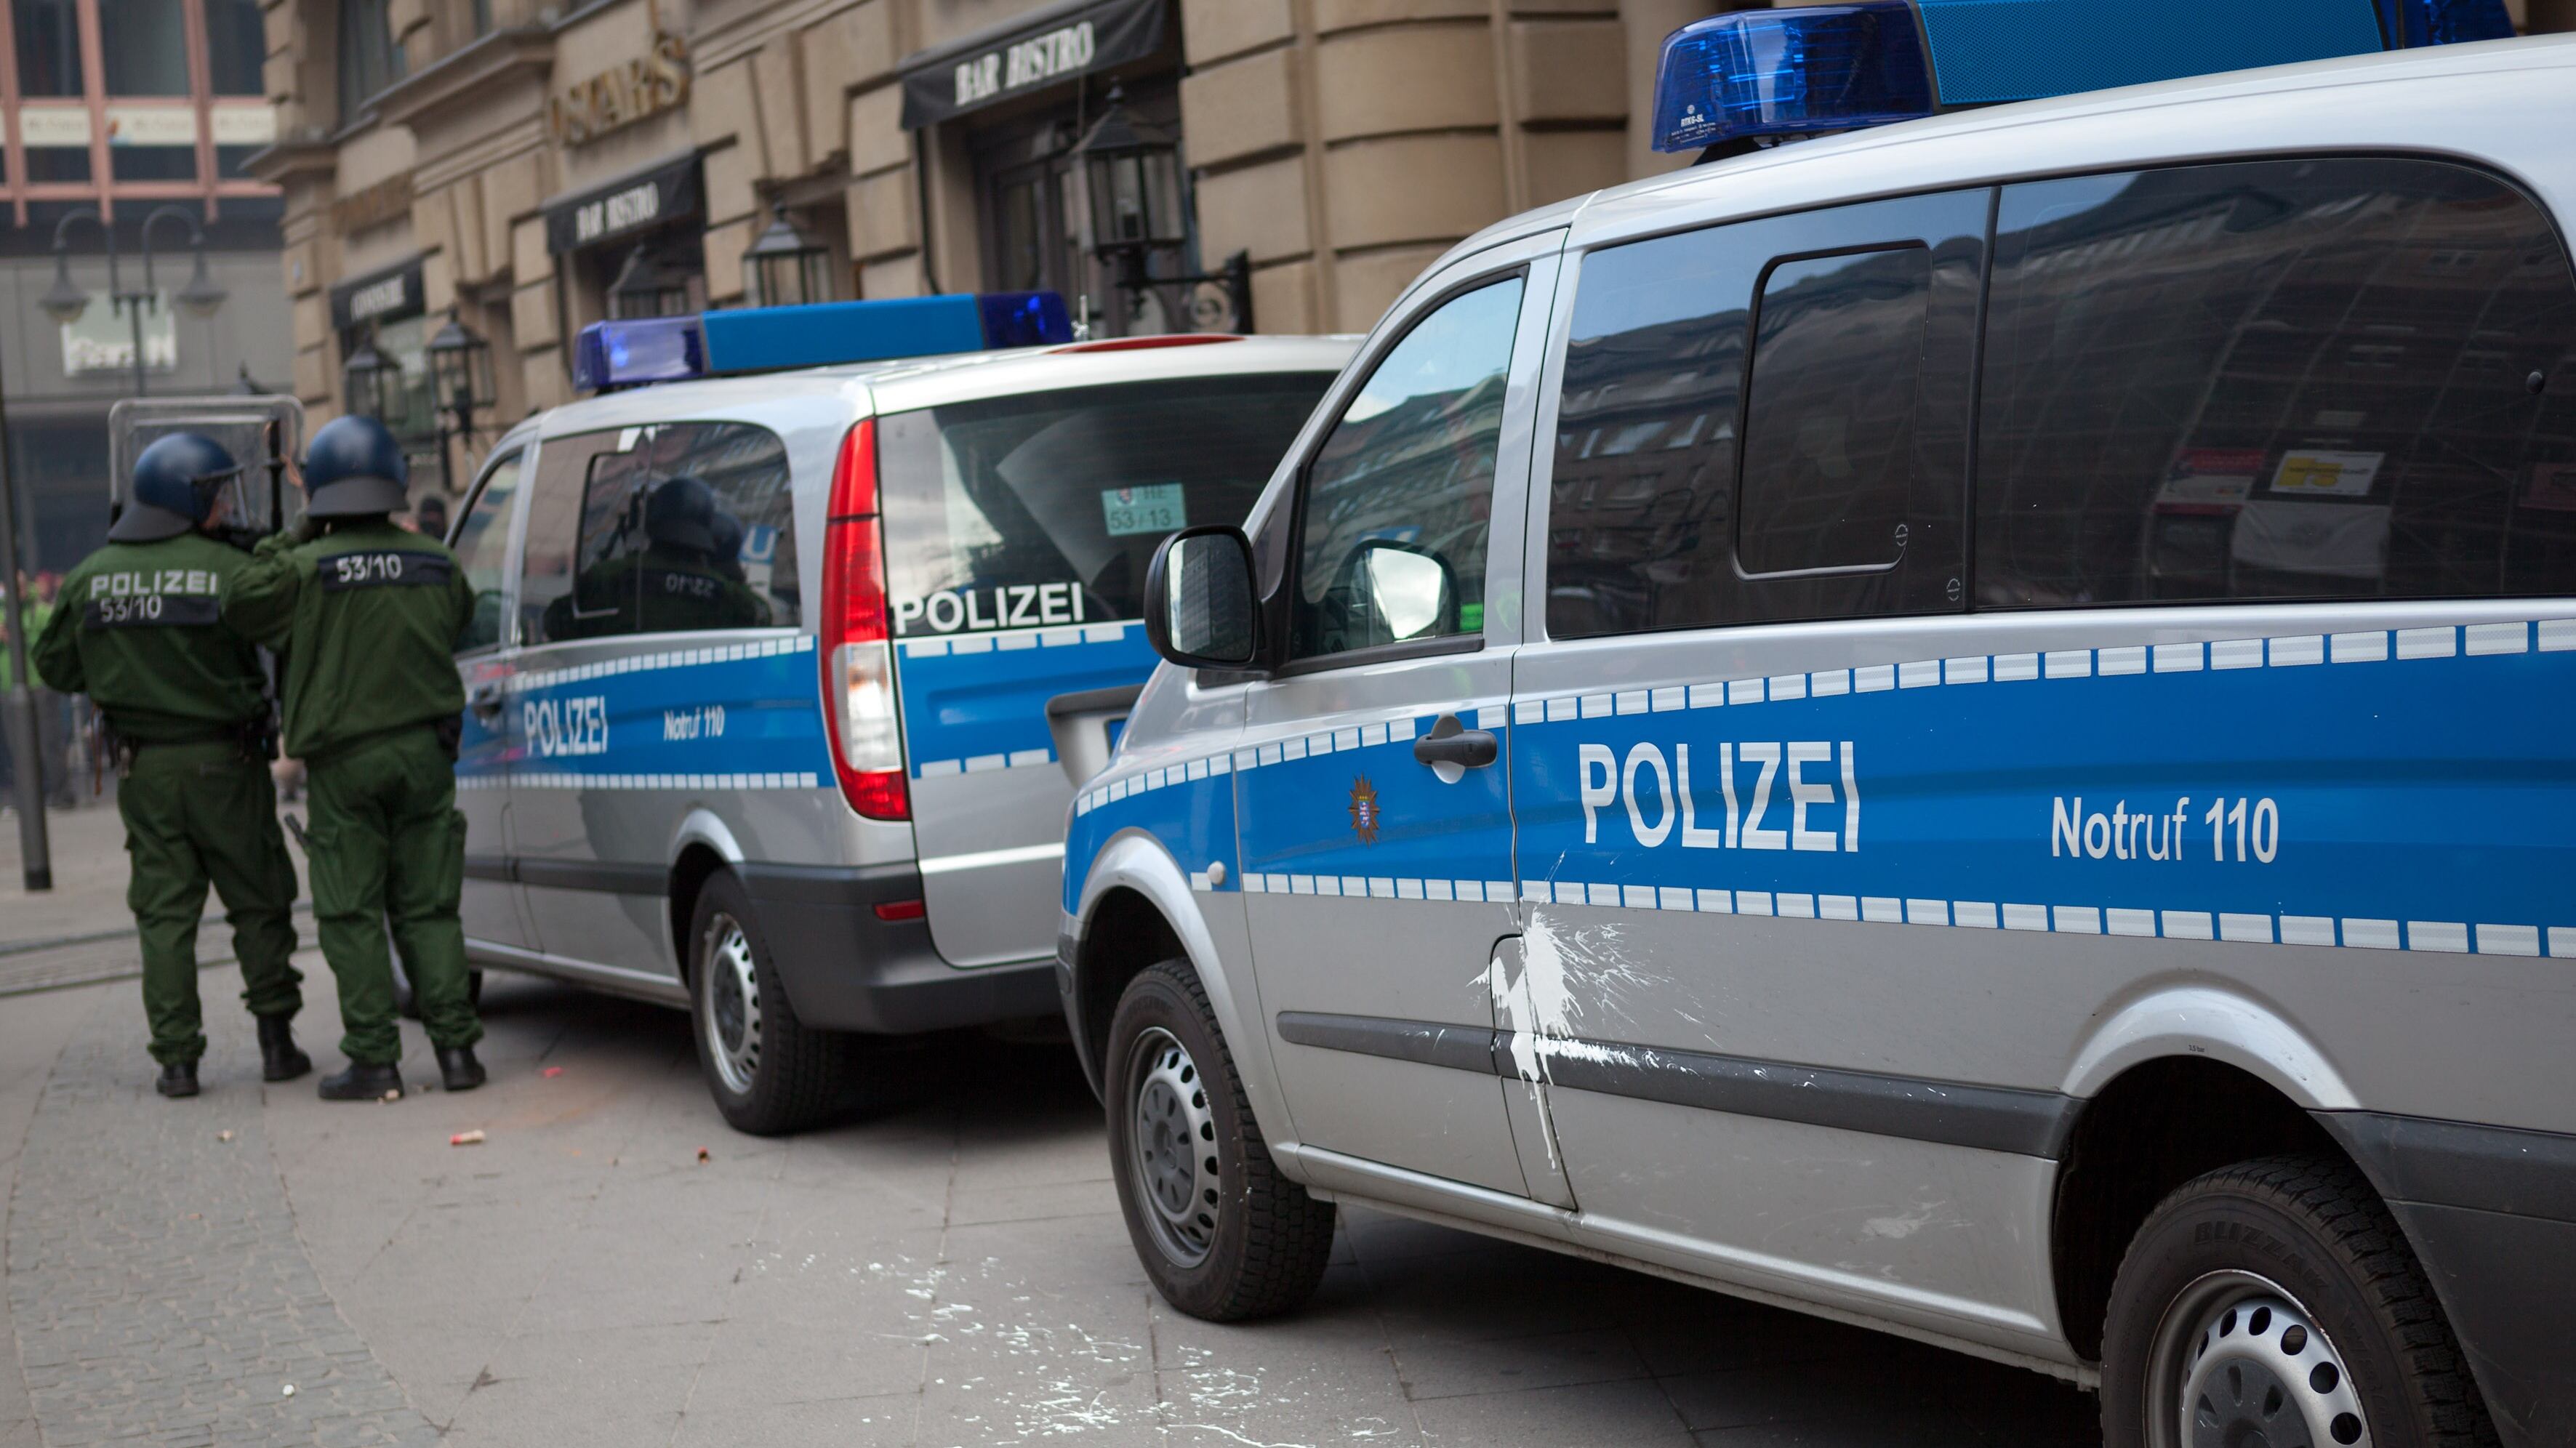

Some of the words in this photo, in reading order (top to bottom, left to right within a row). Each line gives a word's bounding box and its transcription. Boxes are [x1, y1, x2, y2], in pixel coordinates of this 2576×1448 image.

[955, 53, 1000, 106] BAR
[1005, 20, 1095, 89] BISTRO
[576, 201, 603, 243] BAR
[605, 182, 659, 230] BISTRO
[89, 569, 218, 599] POLIZEI
[336, 553, 403, 582] 53/10
[99, 595, 162, 623] 53/10
[894, 581, 1085, 634] POLIZEI
[523, 695, 609, 757] POLIZEI
[663, 707, 701, 741] Notruf
[703, 704, 725, 738] 110
[1578, 741, 1859, 853] POLIZEI
[2052, 795, 2188, 861] Notruf
[2205, 797, 2279, 864] 110
[2194, 1221, 2328, 1295] BLIZZAK
